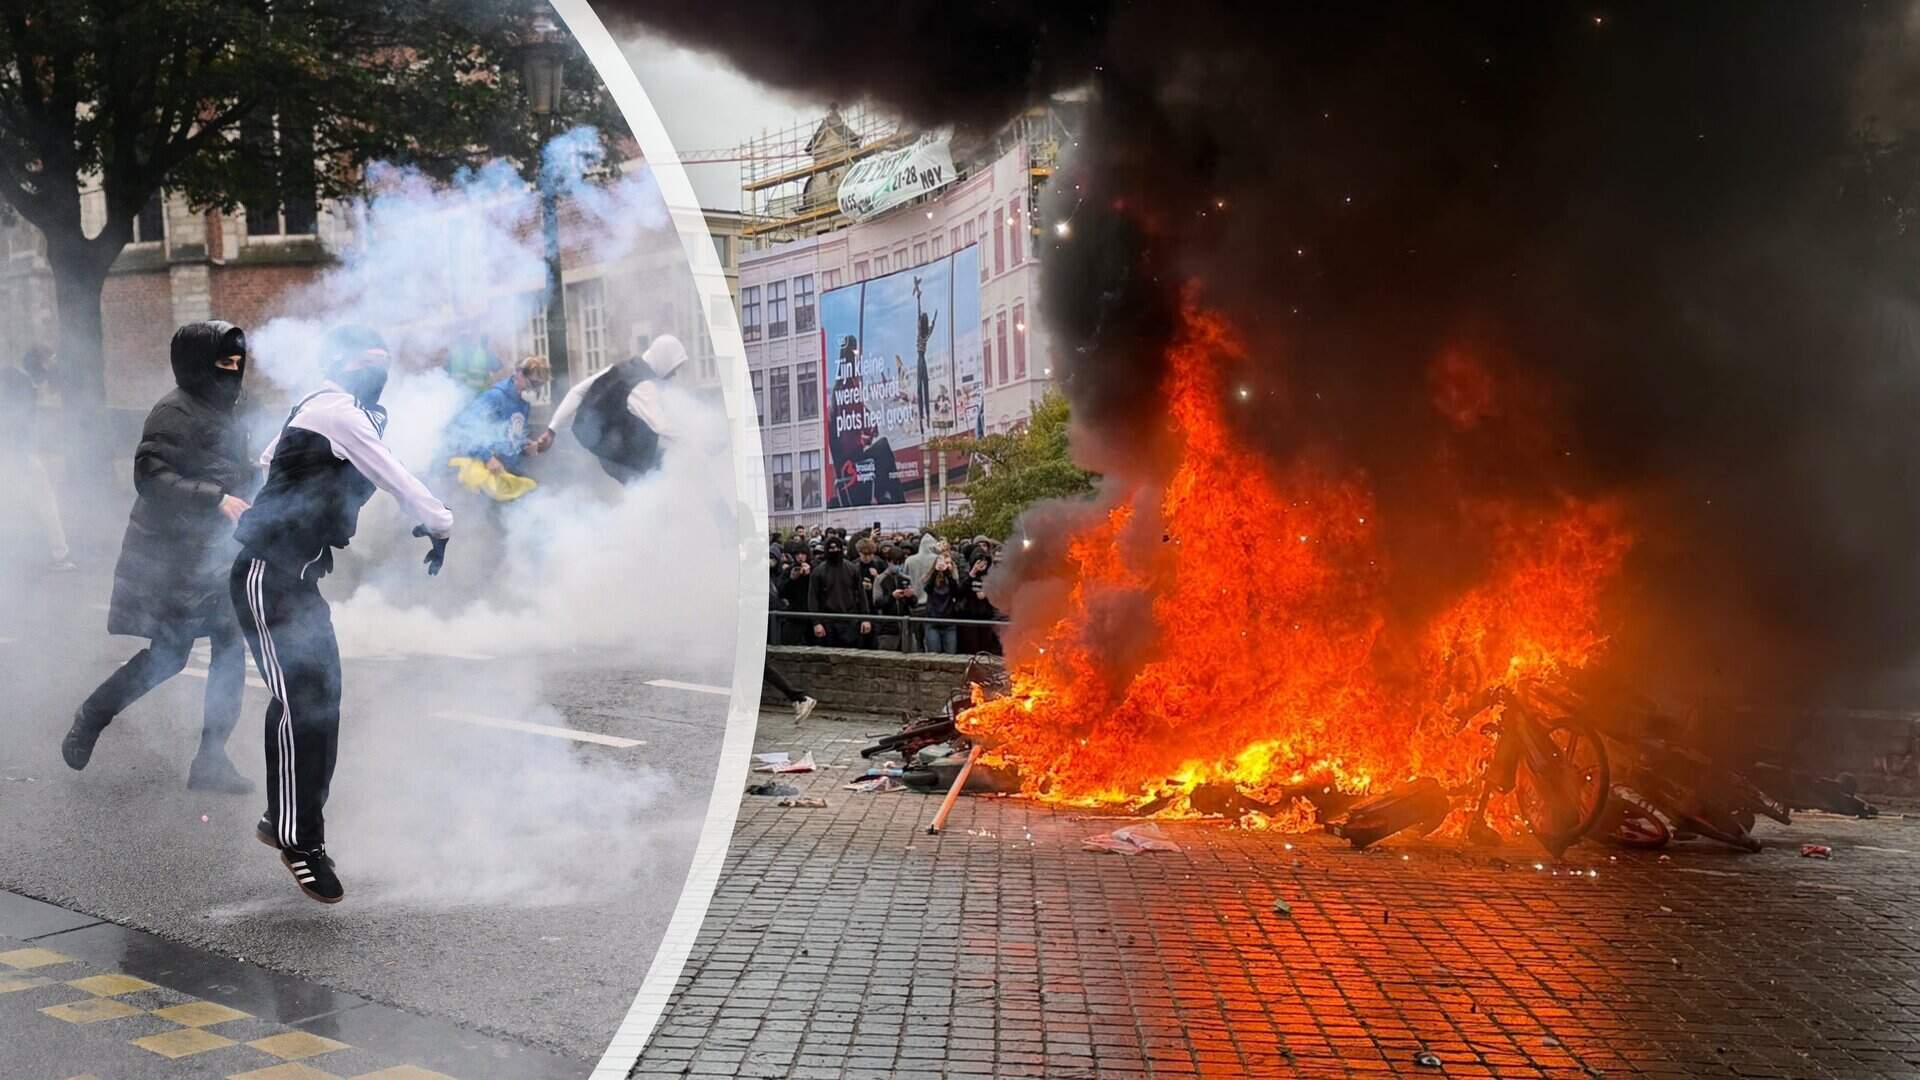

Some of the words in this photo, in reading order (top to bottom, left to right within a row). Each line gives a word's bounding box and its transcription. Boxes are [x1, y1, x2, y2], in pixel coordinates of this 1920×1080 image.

[920, 166, 942, 189] NOV
[835, 360, 853, 384] Zijn
[854, 353, 884, 376] kleine
[835, 382, 868, 405] wereld
[870, 377, 900, 400] wordt
[836, 409, 862, 436] plots
[863, 405, 885, 428] heel
[887, 404, 914, 430] groot
